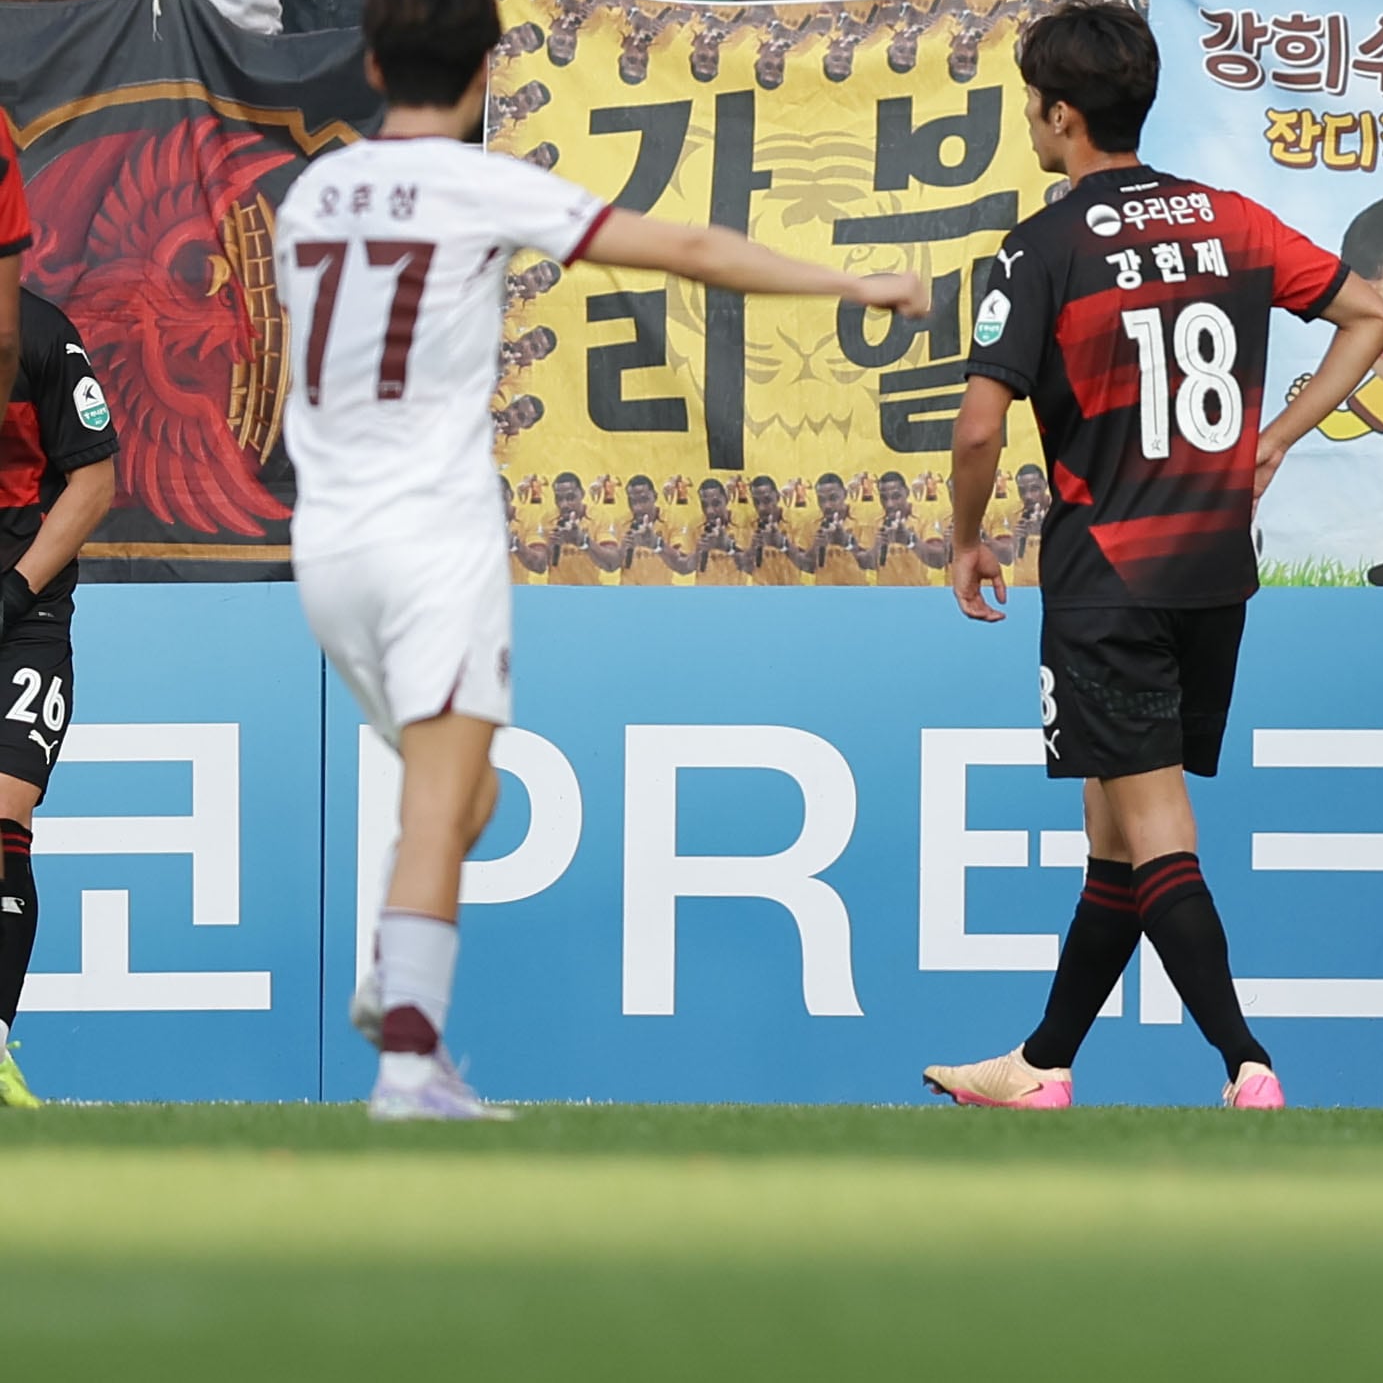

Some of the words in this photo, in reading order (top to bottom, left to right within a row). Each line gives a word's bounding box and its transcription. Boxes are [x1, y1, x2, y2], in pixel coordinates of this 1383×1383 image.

[1121, 192, 1216, 231] 우리은행
[294, 240, 438, 410] 77
[1121, 301, 1245, 461] 18
[5, 666, 66, 732] 26
